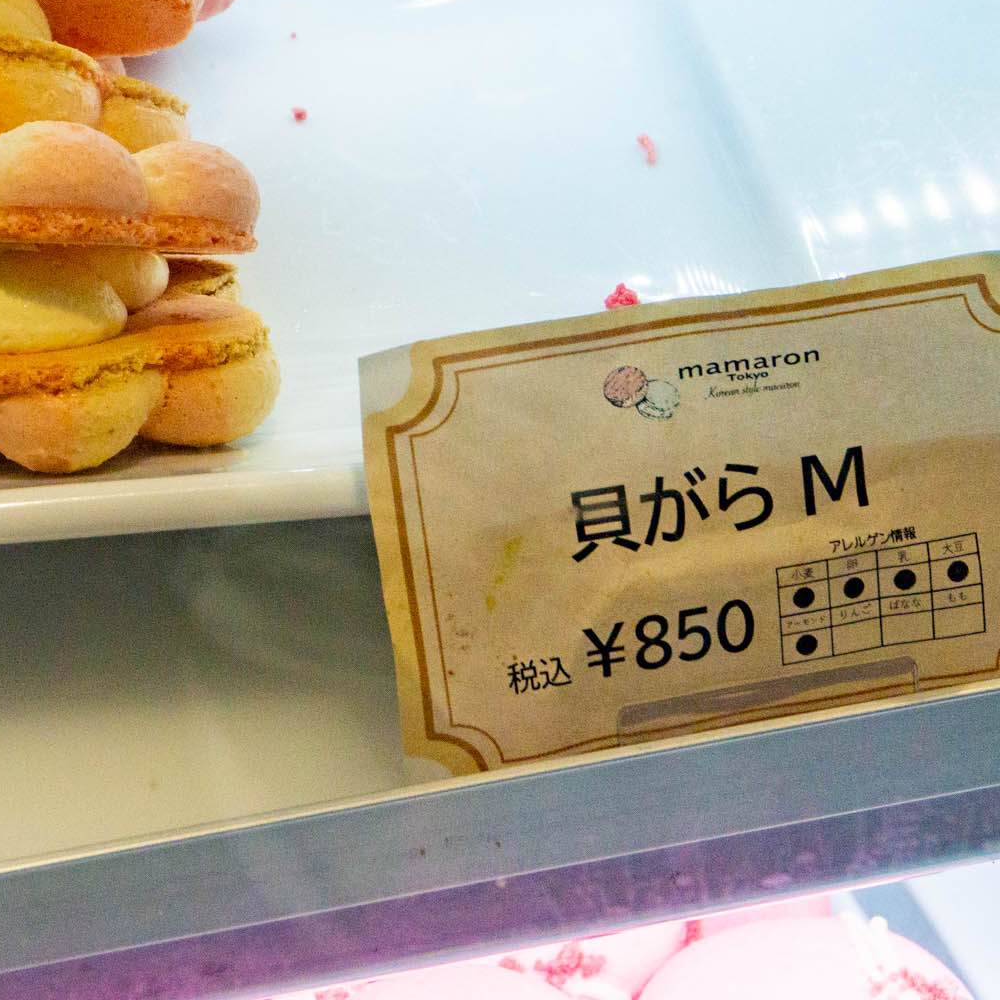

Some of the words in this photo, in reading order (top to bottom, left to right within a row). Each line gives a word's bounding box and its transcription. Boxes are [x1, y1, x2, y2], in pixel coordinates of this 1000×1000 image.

[678, 349, 820, 380] mamaron
[726, 370, 770, 386] Tokyo
[570, 463, 775, 562] 貝がら
[800, 445, 871, 517] M
[828, 526, 918, 553] アレルゲン情報
[941, 540, 965, 556] 大豆
[507, 656, 573, 696] 税込
[581, 598, 756, 678] ¥850
